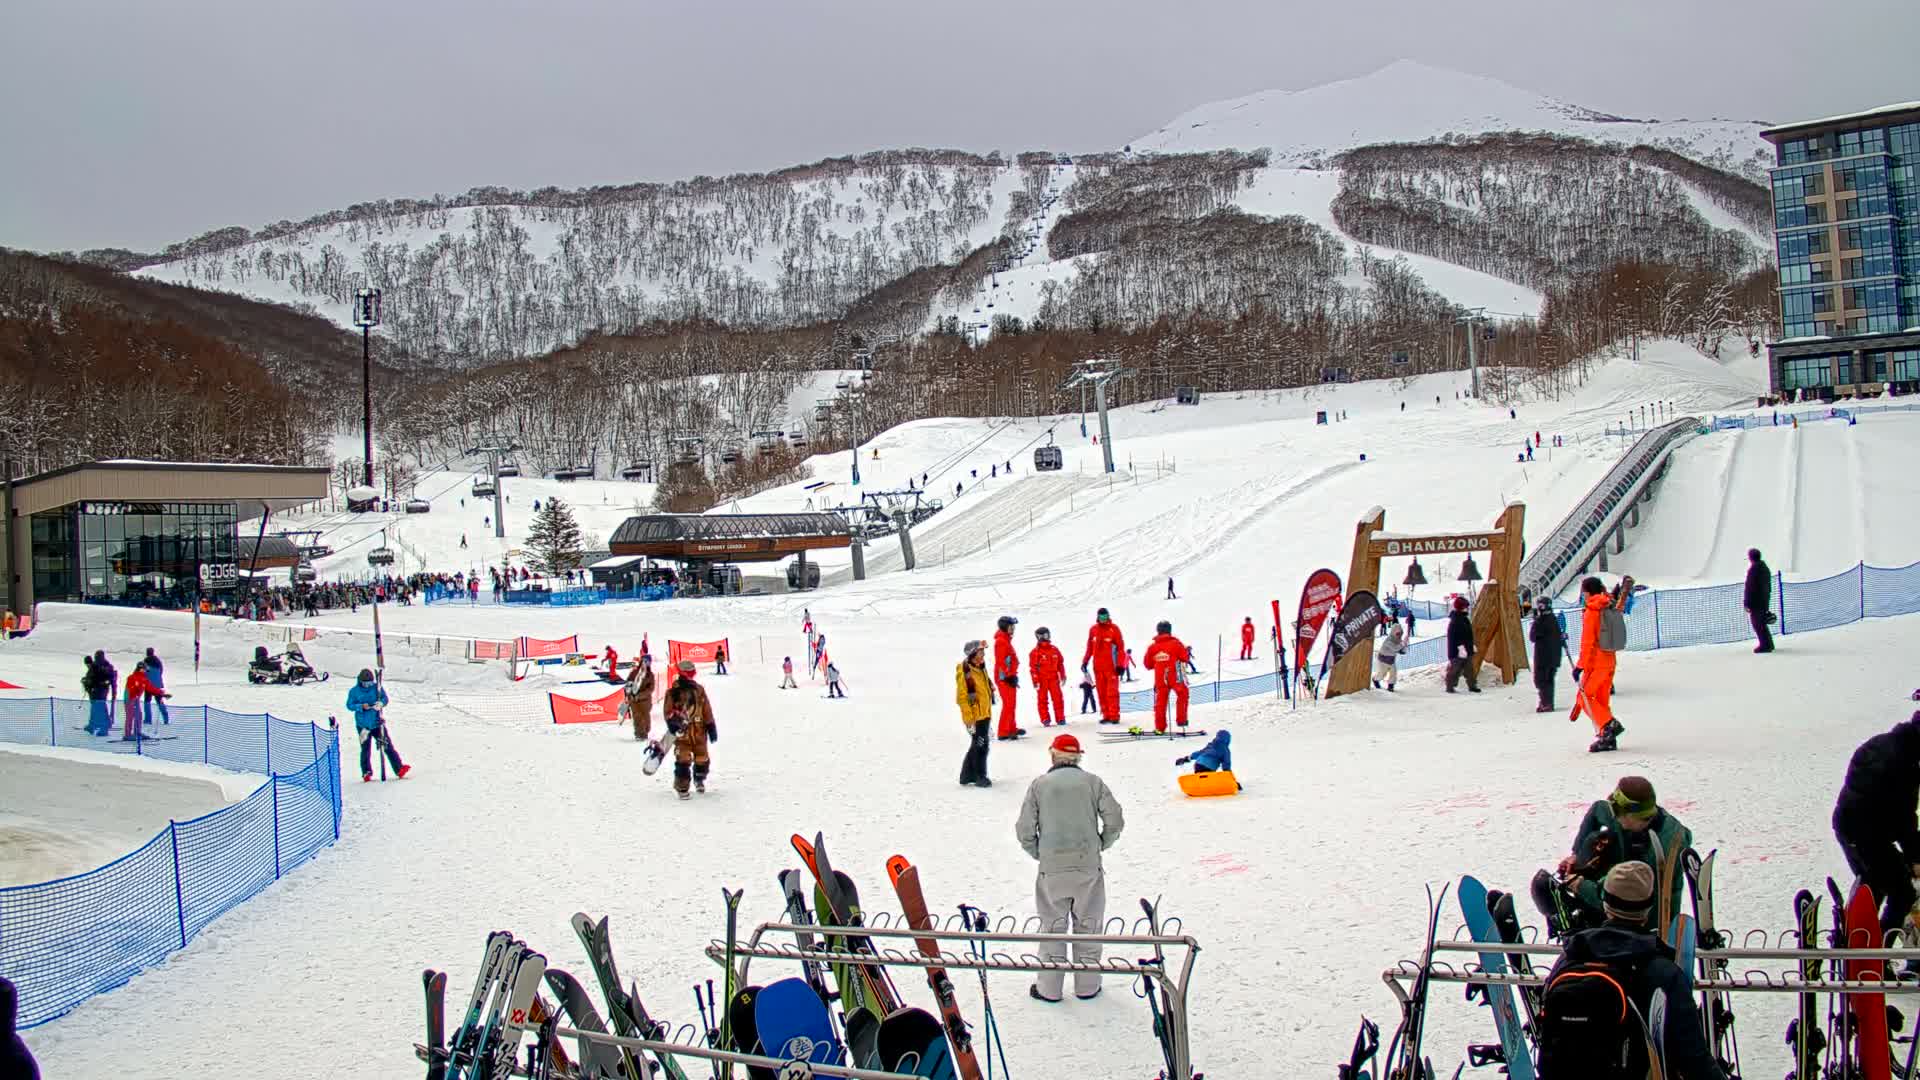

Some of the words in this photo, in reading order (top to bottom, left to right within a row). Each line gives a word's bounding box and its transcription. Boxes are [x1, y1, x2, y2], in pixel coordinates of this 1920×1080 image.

[1402, 538, 1489, 552] HANAZONO
[209, 563, 236, 579] EDGE
[1344, 606, 1378, 636] PRIVATE
